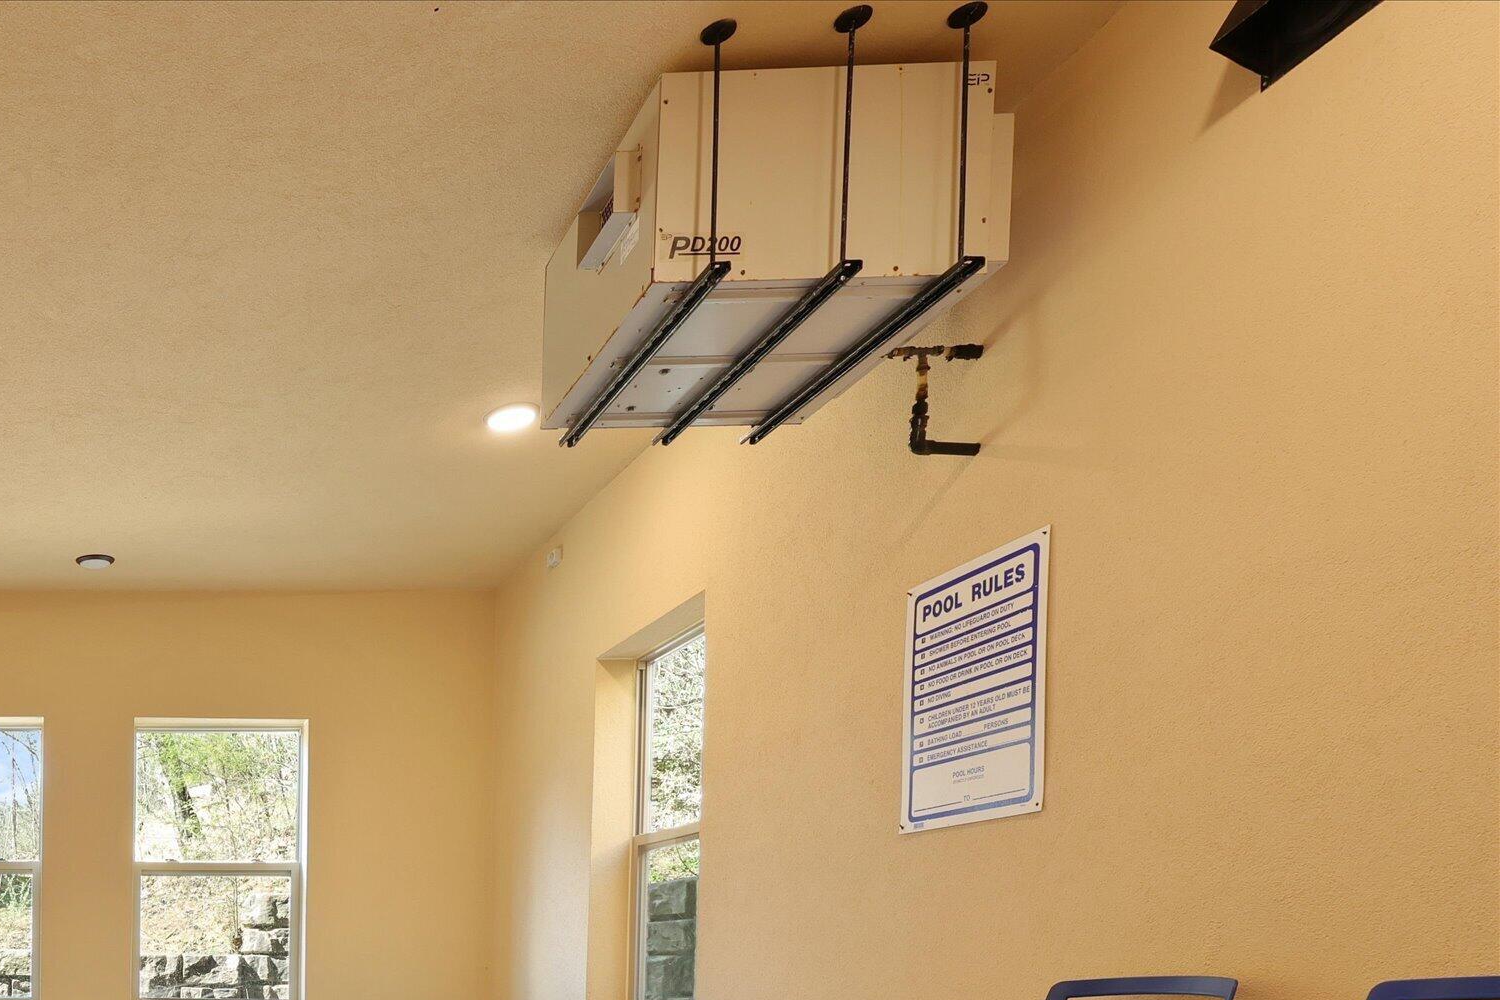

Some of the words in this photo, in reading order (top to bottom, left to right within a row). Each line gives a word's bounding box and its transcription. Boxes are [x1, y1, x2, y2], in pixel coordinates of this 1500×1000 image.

[923, 592, 962, 622] POOL
[972, 564, 1025, 601] RULES
[963, 613, 990, 628] LIFEGUARD
[991, 609, 999, 618] ON
[1000, 603, 1014, 614] DUTY
[929, 644, 949, 656] SHOWER
[950, 636, 969, 649] BEFORE
[970, 625, 996, 641] ENTERING
[997, 621, 1011, 631] POOL
[928, 664, 936, 673] NO
[937, 657, 957, 669] ANIMALS
[964, 649, 977, 660] POOL
[978, 646, 985, 655] OR
[986, 643, 994, 652] ON
[996, 638, 1010, 649] POOL
[1011, 633, 1025, 643] DECK
[936, 675, 949, 686] FOOD
[958, 668, 973, 680] DRINK
[980, 661, 994, 671] POOL
[995, 657, 1003, 666] OR
[1004, 653, 1012, 662] ON
[1013, 649, 1028, 659] DECK
[928, 695, 936, 704] NO
[936, 691, 952, 701] DIVING
[928, 710, 951, 721] CHILDREN
[952, 704, 969, 715] UNDER
[977, 698, 994, 708] YEARS
[995, 694, 1005, 703] OLD
[1006, 688, 1022, 698] MUST
[1023, 686, 1030, 694] BE
[928, 715, 962, 729] ACCOMPANIED
[979, 704, 996, 715] ADULT
[949, 731, 962, 740] LOAD
[983, 718, 1009, 730] PERSONS
[927, 749, 956, 761] EMERGENCY
[957, 741, 988, 754] ASSISTANCE
[967, 766, 985, 775] HOURS
